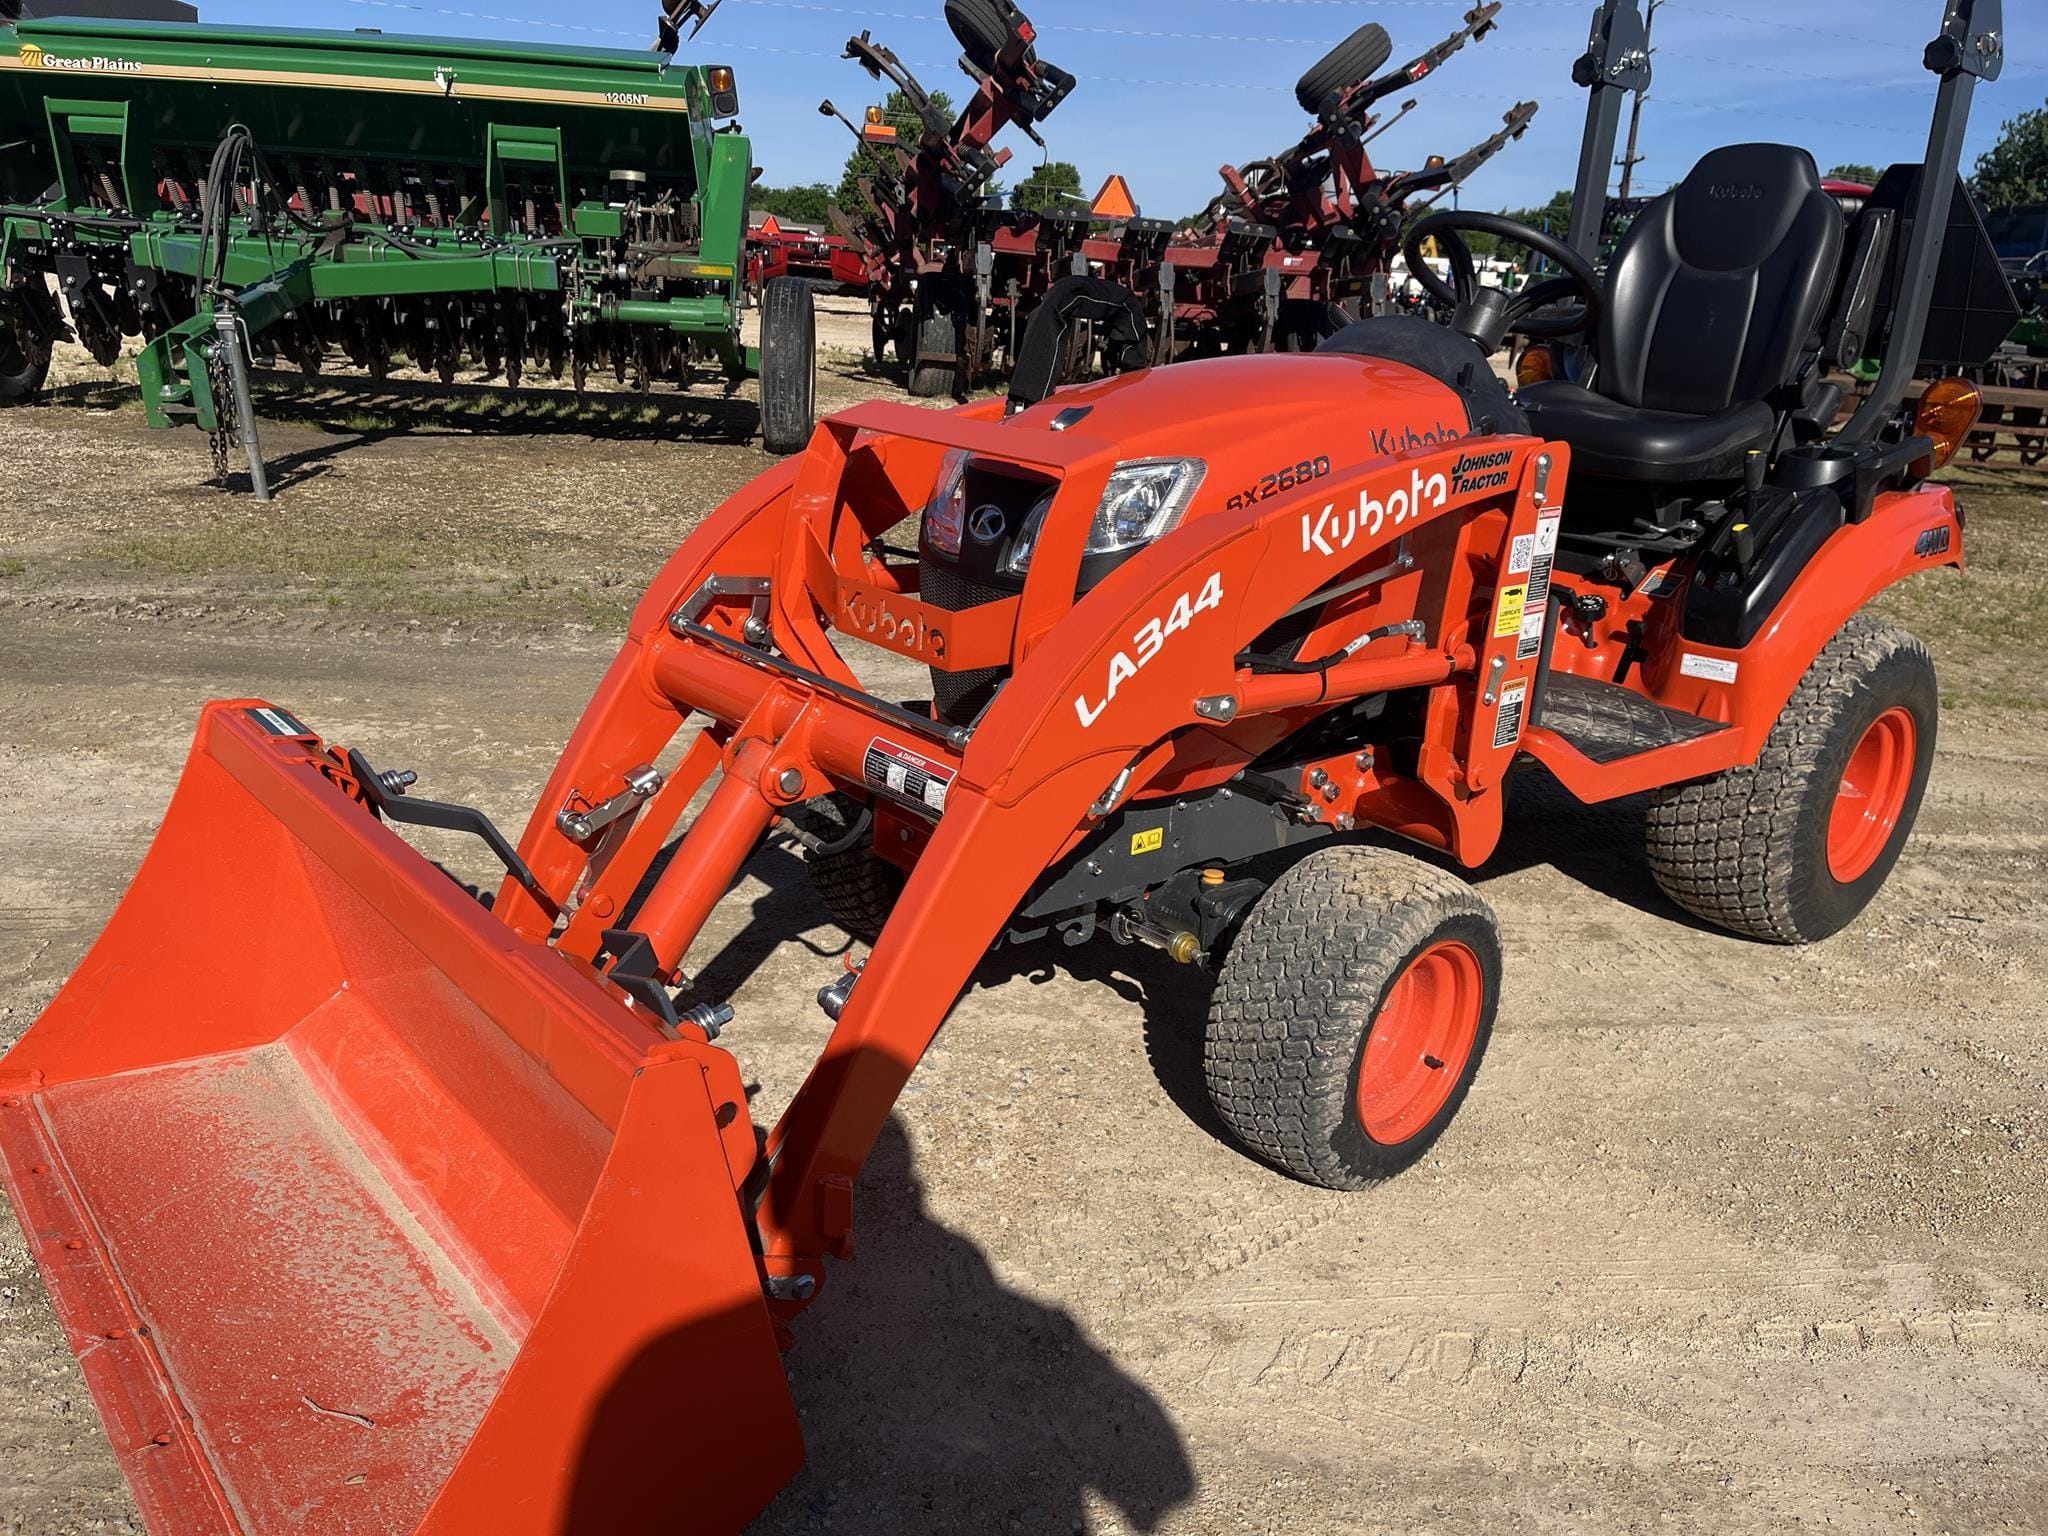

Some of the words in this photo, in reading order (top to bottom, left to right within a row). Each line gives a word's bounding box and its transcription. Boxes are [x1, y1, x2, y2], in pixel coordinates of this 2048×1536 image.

[42, 54, 92, 70] Great
[92, 56, 142, 72] Plains
[605, 92, 649, 105] 1205NT
[1709, 184, 1763, 200] Kubota
[1369, 421, 1460, 456] Kubota
[1451, 450, 1513, 474] JOHNSON
[1451, 471, 1509, 495] TRACTOR
[1302, 468, 1447, 557] Kubota
[1914, 525, 1950, 559] 4WD
[841, 586, 947, 660] Kubota
[1074, 571, 1224, 728] LA344
[903, 753, 927, 768] DANGER
